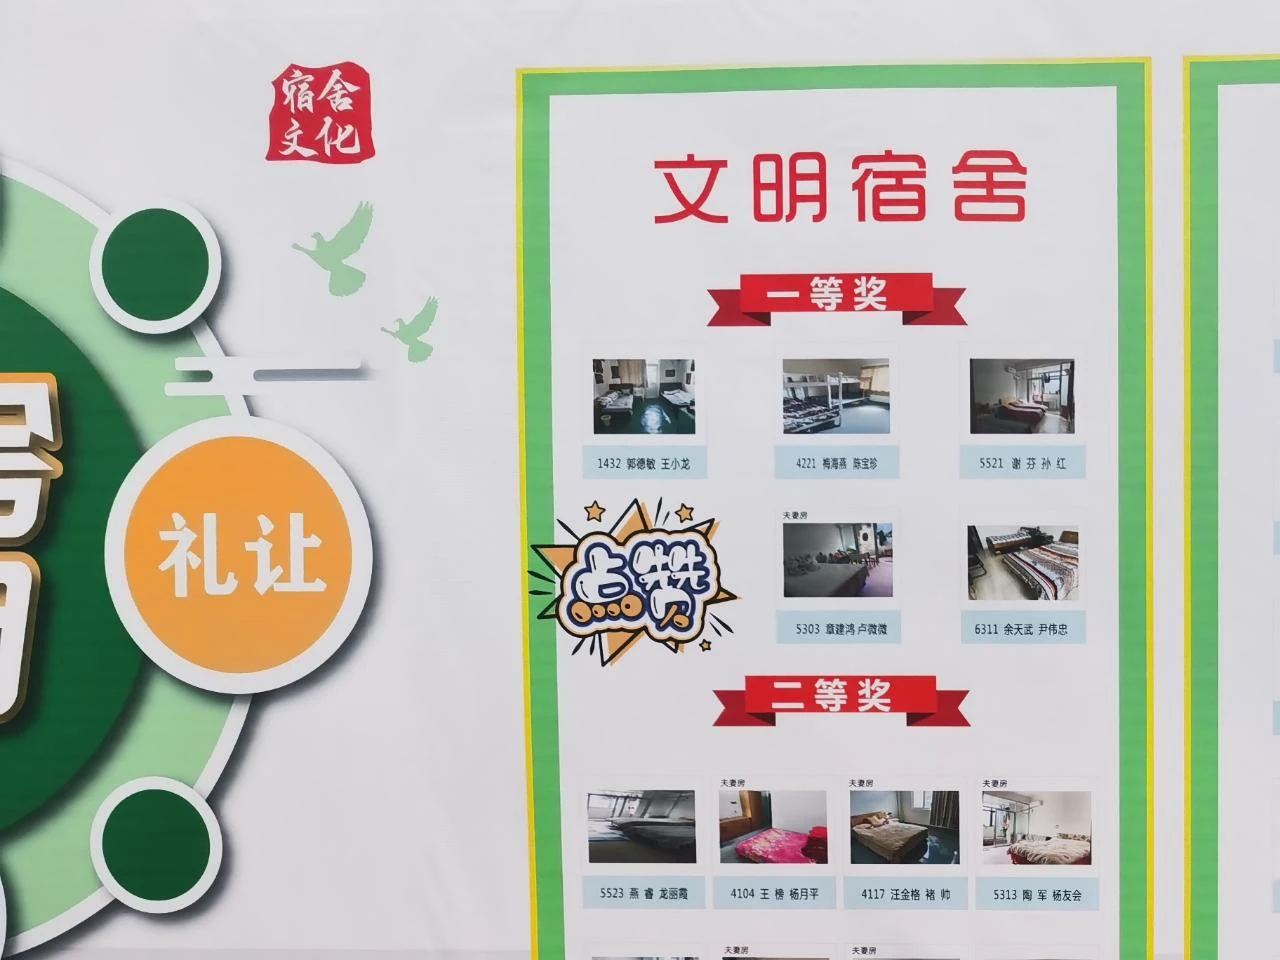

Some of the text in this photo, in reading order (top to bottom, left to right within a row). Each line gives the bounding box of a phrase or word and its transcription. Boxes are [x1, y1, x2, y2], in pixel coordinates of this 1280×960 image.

[279, 67, 361, 113] 宿舍
[278, 116, 361, 157] 文化
[654, 149, 1027, 224] 文明宿舍
[766, 275, 888, 311] 一等奖
[597, 456, 691, 471] 1432 郭德敏 王小龙
[795, 457, 817, 469] 4221
[852, 456, 878, 471] 陈宝珍
[979, 456, 1004, 469] 5521
[782, 511, 809, 520] 夫妻房
[157, 511, 327, 598] 礼让
[567, 540, 711, 632] 点赞
[795, 623, 821, 635] 5303
[856, 622, 888, 636] 卢微微
[974, 623, 999, 635] 6311
[1037, 622, 1068, 636] 尹伟忠
[771, 678, 891, 712] 二等奖
[720, 778, 746, 788] 夫妻房
[848, 778, 874, 788] 夫妻房
[981, 779, 1008, 789] 夫妻房
[599, 887, 625, 899] 5523
[730, 887, 755, 900] 4104
[789, 887, 820, 901] 杨月平
[861, 888, 886, 900] 4117
[889, 887, 921, 902] 汪金格
[993, 888, 1018, 901] 5313
[1051, 888, 1083, 902] 杨友会
[724, 945, 749, 955] 夫妻房
[851, 946, 877, 956] 夫妻房
